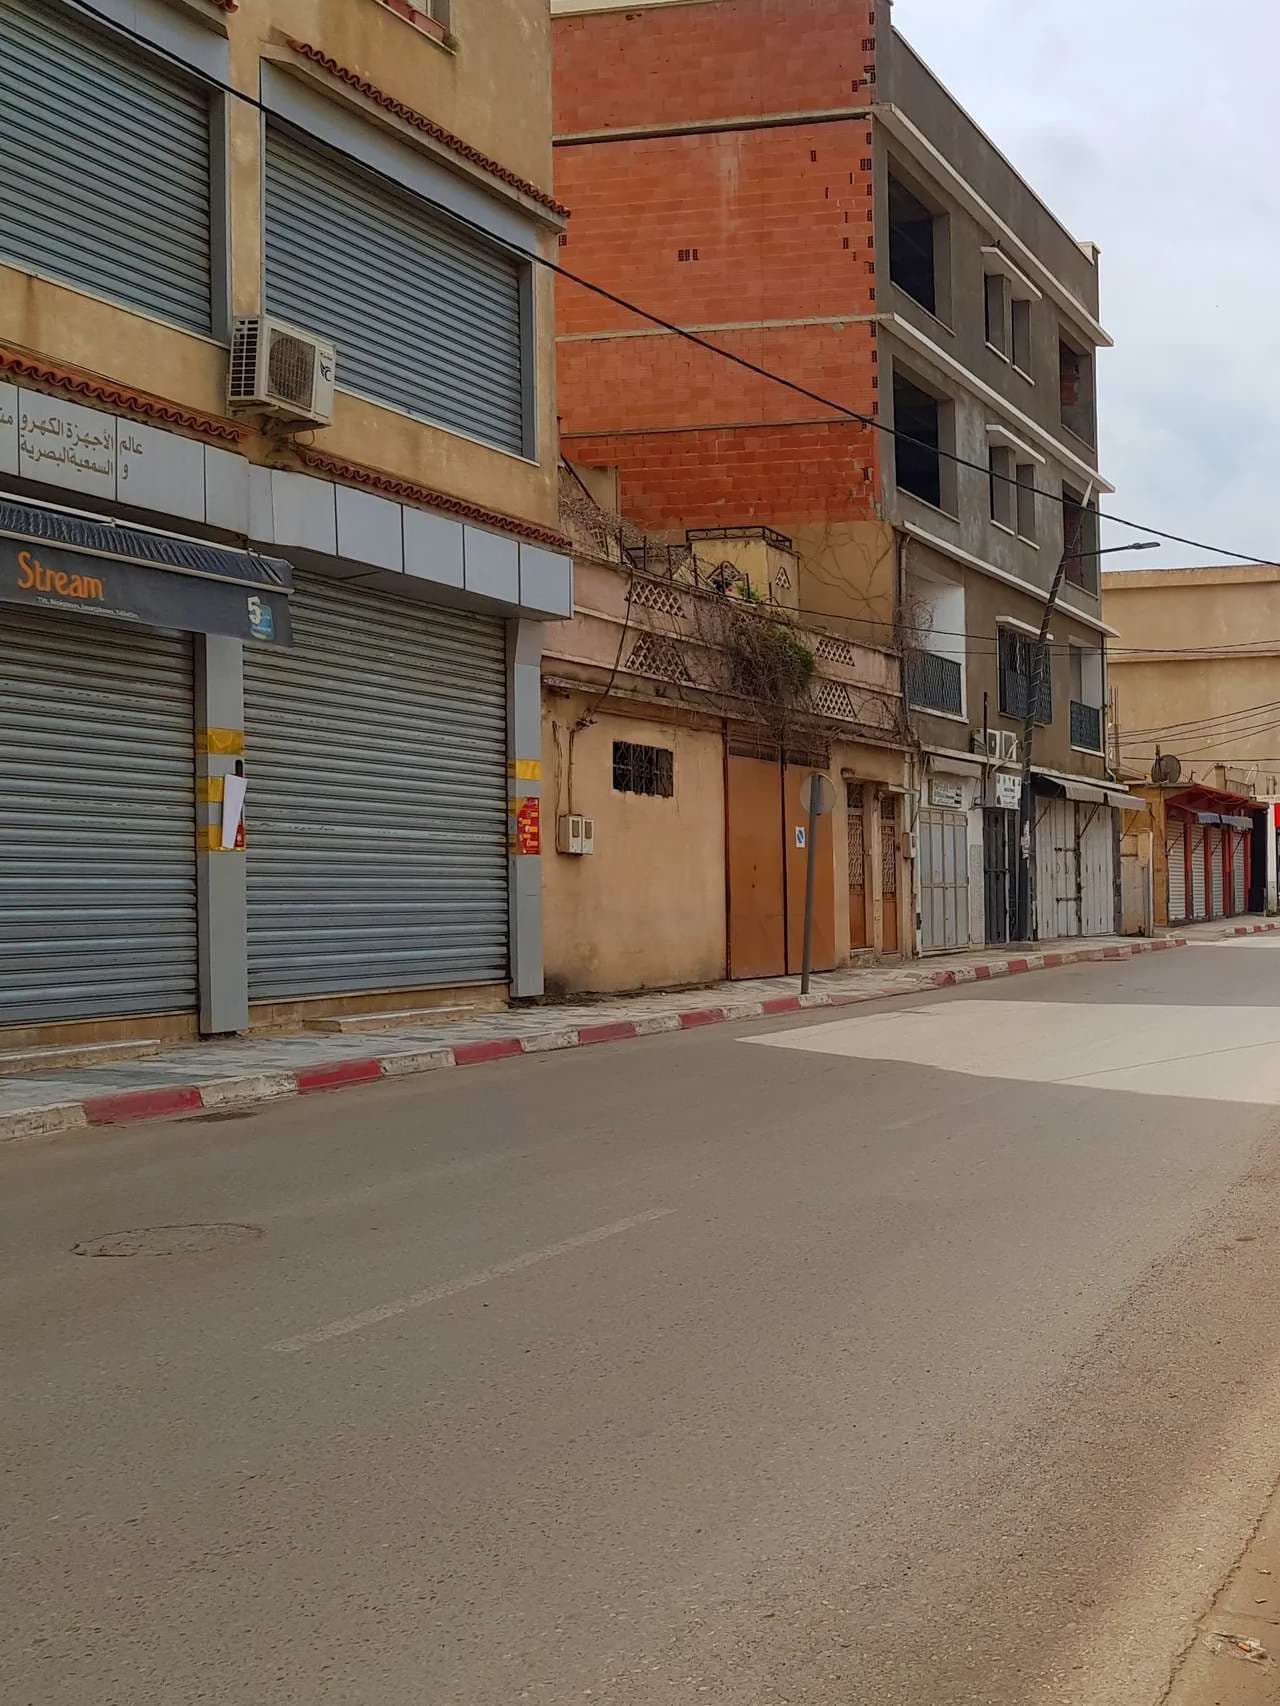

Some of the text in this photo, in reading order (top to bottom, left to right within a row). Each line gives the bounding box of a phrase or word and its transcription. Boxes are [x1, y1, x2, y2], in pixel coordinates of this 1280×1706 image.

[65, 422, 115, 452] الأجهزة
[119, 436, 144, 456] عالم
[16, 550, 105, 601] Stream
